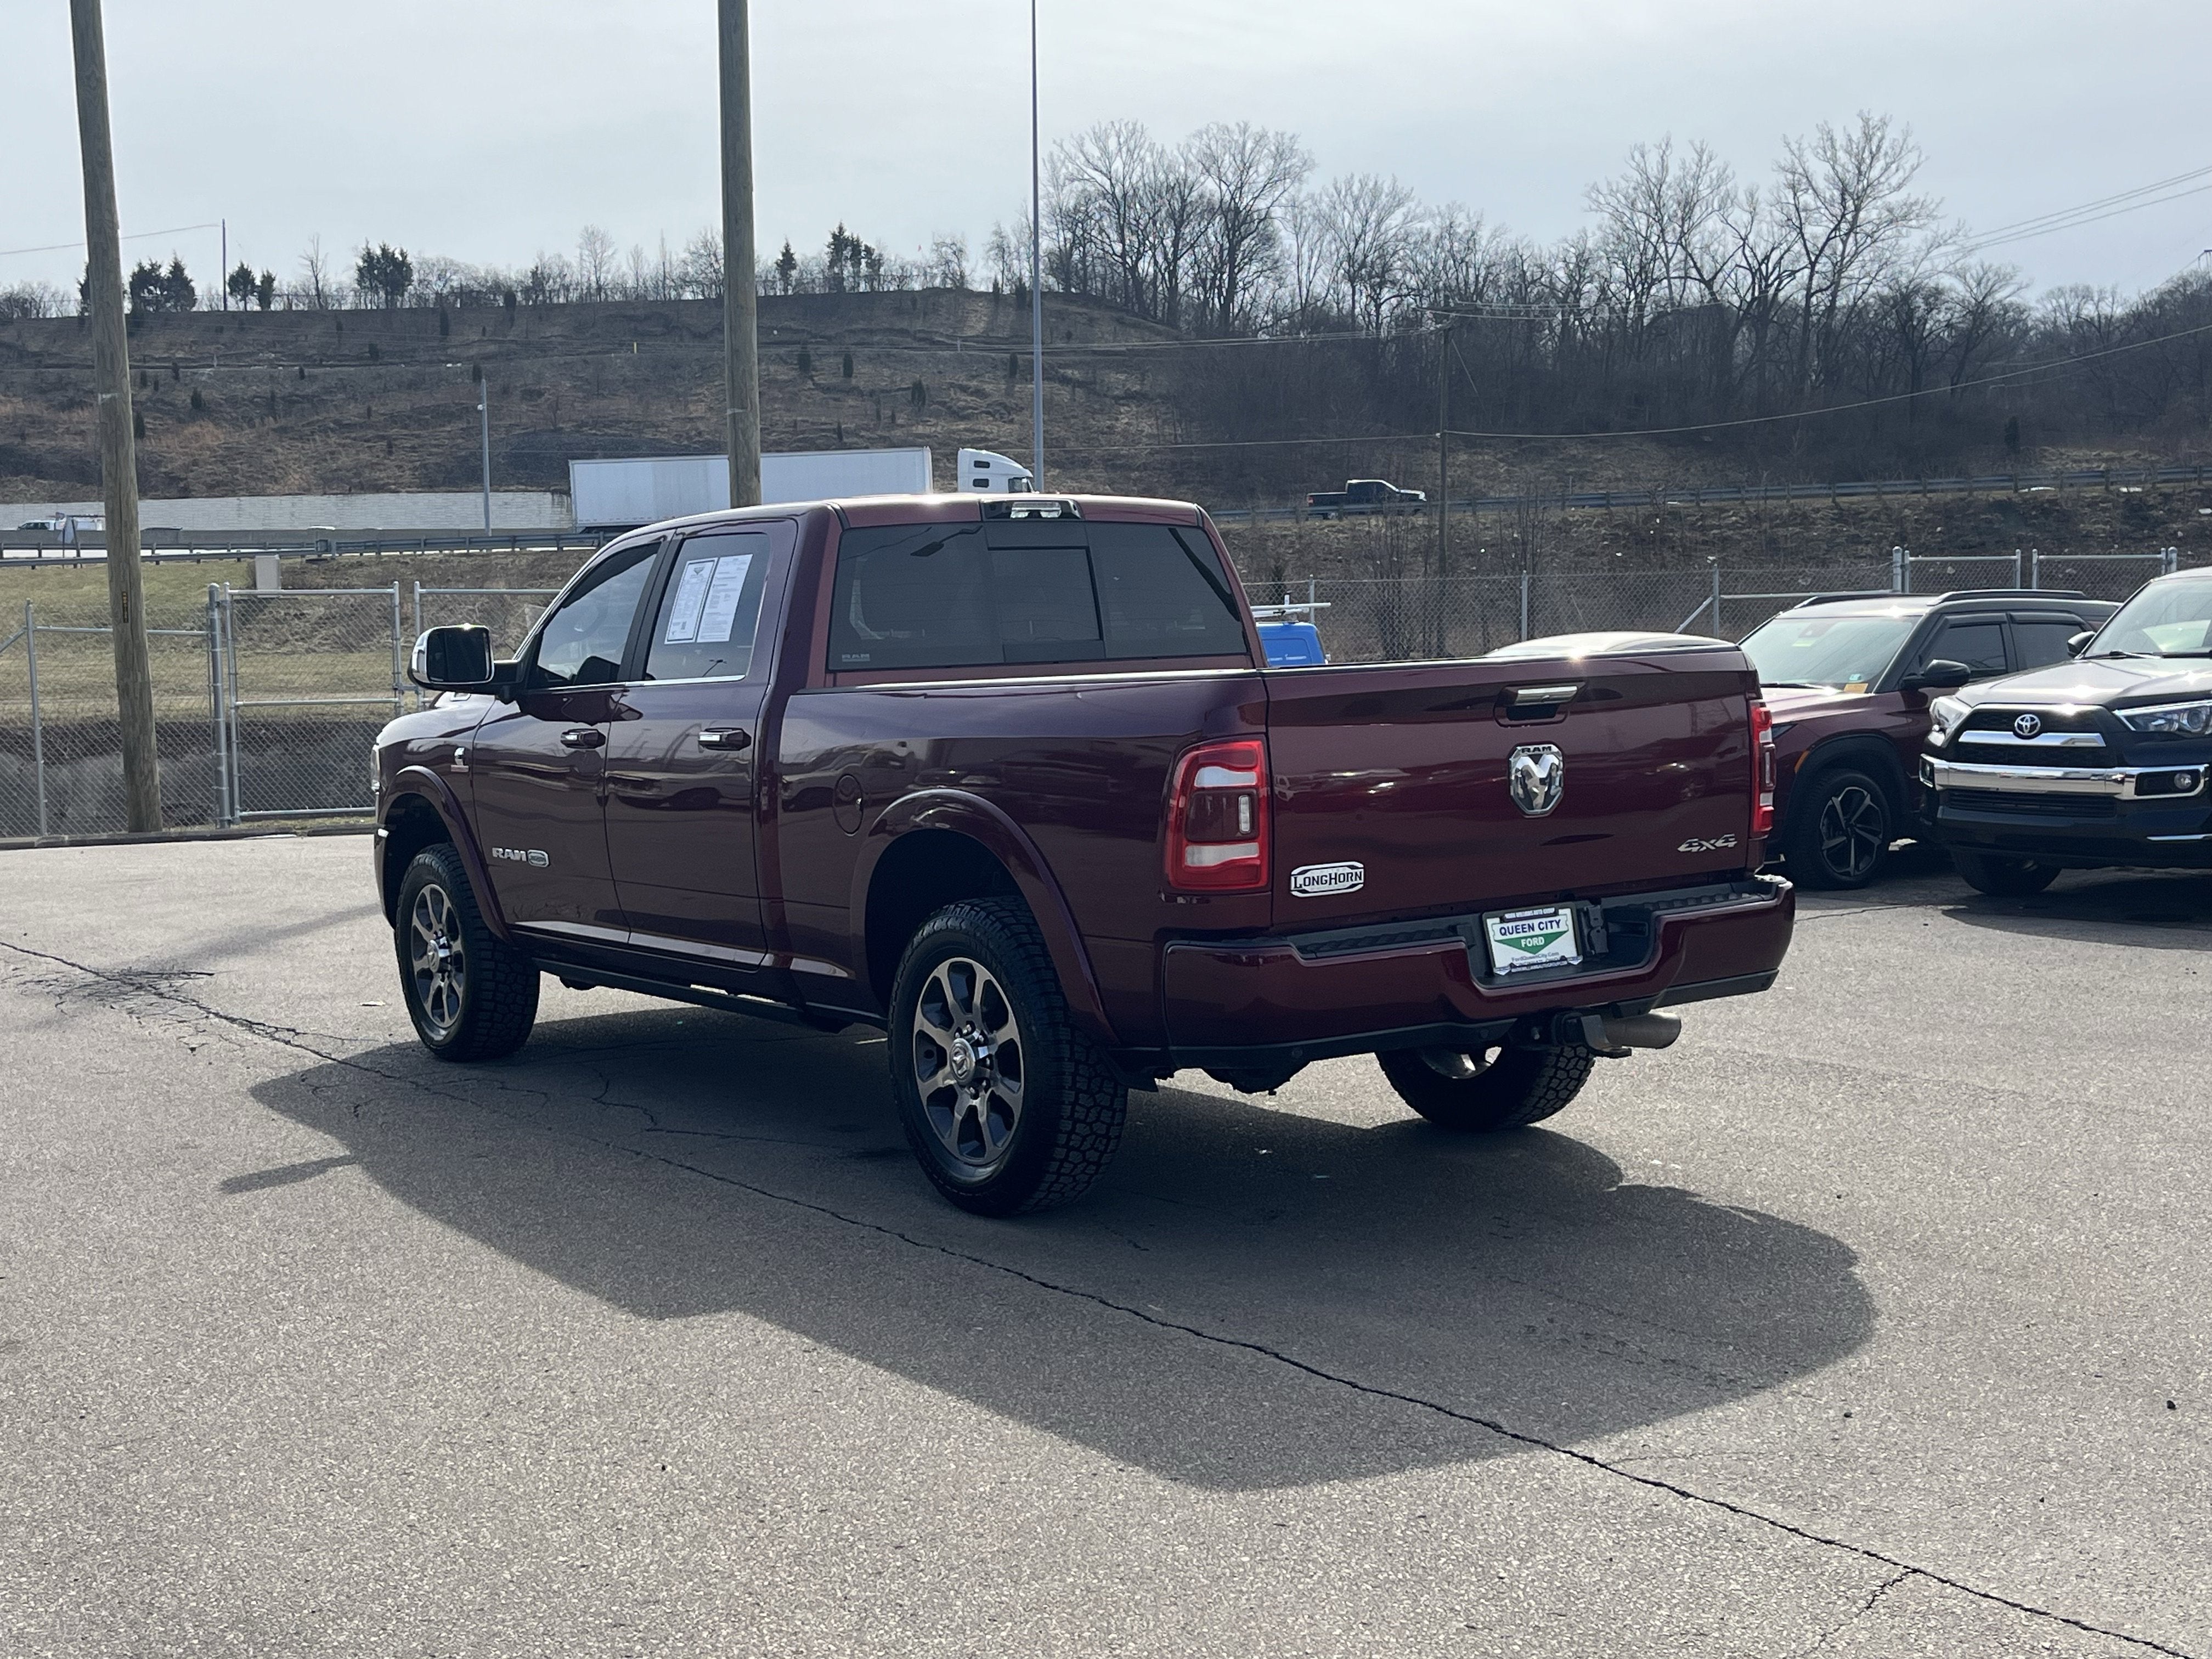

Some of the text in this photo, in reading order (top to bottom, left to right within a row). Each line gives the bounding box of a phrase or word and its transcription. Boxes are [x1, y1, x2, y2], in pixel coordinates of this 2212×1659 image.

[492, 847, 527, 862] RAM
[1294, 871, 1363, 889] LONGHORN
[1499, 919, 1561, 936] QUEEN CITY
[1521, 936, 1545, 947] FORD
